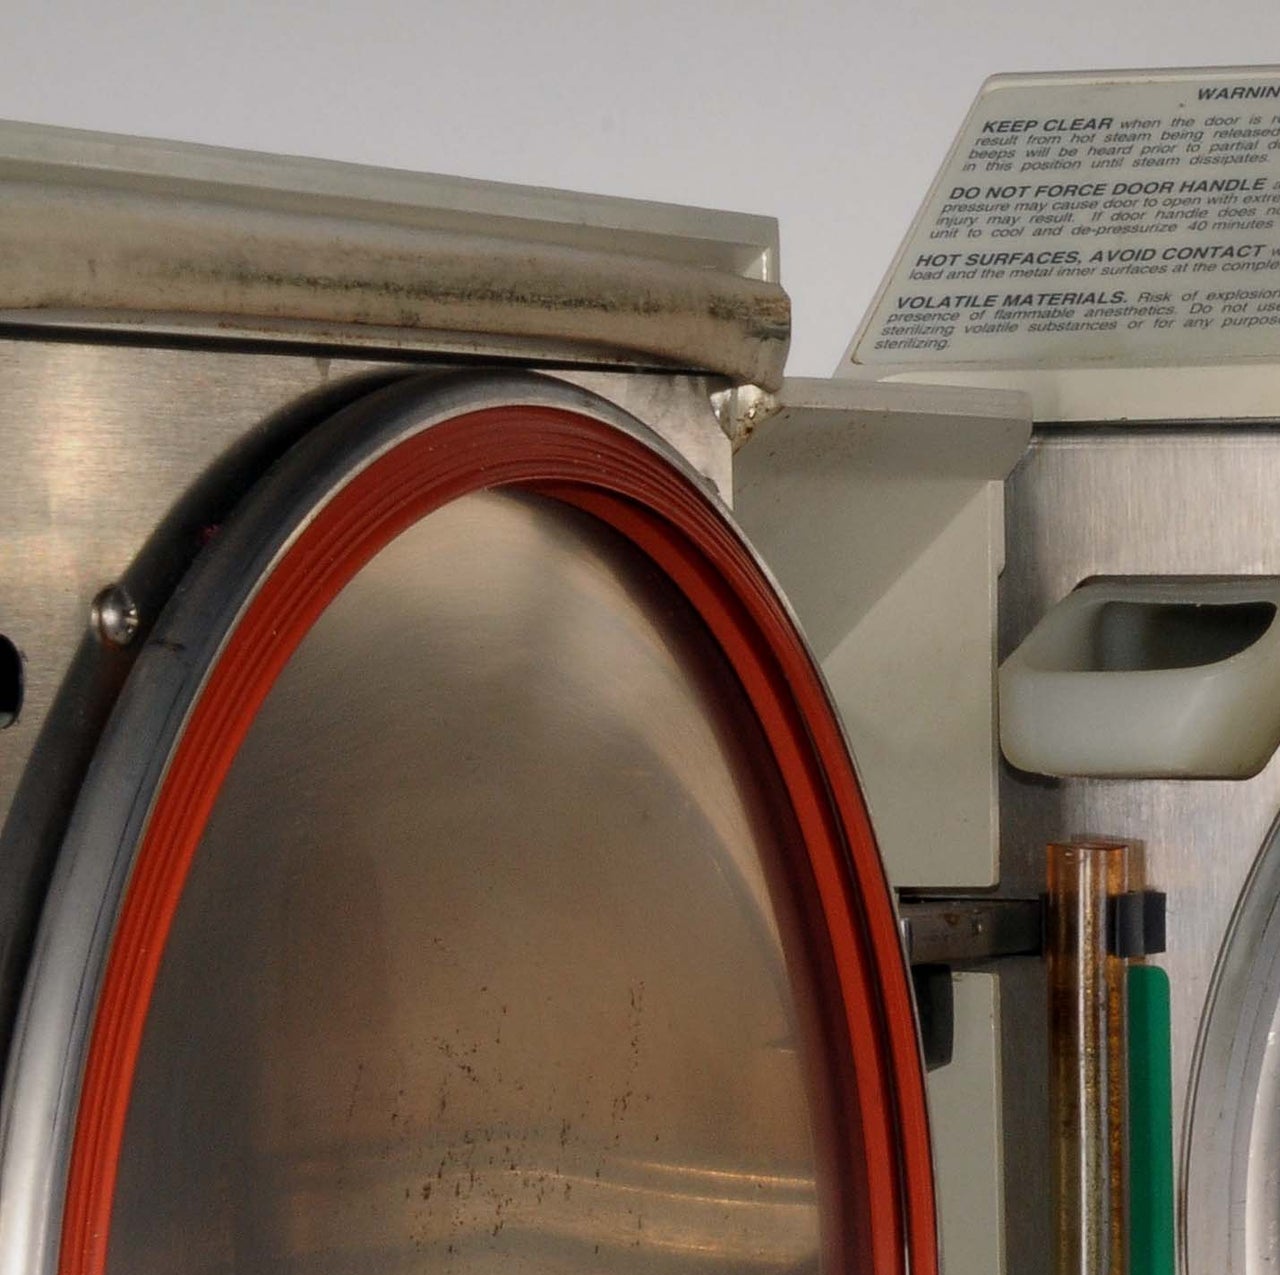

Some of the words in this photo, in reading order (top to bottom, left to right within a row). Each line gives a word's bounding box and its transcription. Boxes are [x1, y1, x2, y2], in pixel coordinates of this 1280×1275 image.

[982, 120, 1038, 133] KEEP
[1043, 118, 1114, 132] CLEAR
[1120, 117, 1161, 129] when
[1171, 116, 1196, 128] the
[1204, 114, 1242, 127] door
[1250, 114, 1262, 125] is
[975, 134, 1019, 147] result
[1026, 134, 1062, 146] from
[1070, 132, 1097, 144] hot
[1104, 131, 1152, 144] steam
[1161, 130, 1204, 145] being
[968, 148, 1016, 162] beeps
[1026, 147, 1050, 158] will
[1058, 146, 1078, 158] be
[1087, 144, 1134, 156] heard
[1140, 143, 1178, 158] prior
[1186, 142, 1202, 153] to
[1208, 139, 1260, 154] partial
[962, 161, 976, 172] in
[985, 160, 1012, 172] this
[1020, 158, 1082, 173] position
[1091, 157, 1124, 170] until
[1132, 156, 1180, 168] steam
[949, 186, 982, 200] DO
[985, 186, 1032, 199] NOT
[1034, 184, 1108, 198] FORCE
[1111, 181, 1174, 196] DOOR
[1179, 178, 1268, 194] HANDLE
[942, 200, 1010, 215] pressure
[1014, 200, 1048, 212] may
[1052, 198, 1098, 211] cause
[1103, 197, 1139, 210] door
[1143, 196, 1158, 208] to
[1162, 195, 1202, 209] open
[1207, 193, 1238, 205] with
[936, 214, 978, 227] injury
[986, 214, 1020, 226] may
[1091, 211, 1104, 222] If
[1110, 210, 1147, 222] door
[1154, 206, 1208, 220] handle
[1218, 206, 1256, 218] does
[930, 228, 960, 240] unit
[967, 227, 982, 239] to
[991, 226, 1025, 238] cool
[1032, 225, 1064, 237] and
[1071, 222, 1178, 238] de-pressurize
[1187, 220, 1208, 231] 40
[1211, 218, 1274, 231] minutes
[916, 254, 962, 268] HOT
[964, 250, 1082, 266] SURFACES,
[1089, 248, 1158, 264] AVOID
[1161, 244, 1267, 261] CONTACT
[908, 268, 944, 281] load
[946, 268, 979, 280] and
[980, 267, 1006, 280] the
[1008, 265, 1054, 279] metal
[1056, 264, 1097, 277] inner
[1100, 262, 1168, 276] surfaces
[1172, 262, 1189, 274] at
[1192, 260, 1218, 273] the
[897, 295, 998, 309] VOLATILE
[1002, 290, 1128, 307] MATERIALS.
[1138, 290, 1172, 303] Risk
[1182, 290, 1198, 302] of
[886, 311, 960, 325] presence
[969, 310, 986, 322] of
[993, 306, 1076, 322] flammable
[1190, 302, 1212, 315] Do
[1221, 302, 1248, 314] not
[881, 324, 955, 338] sterilizing
[964, 320, 1019, 334] volatile
[1028, 318, 1118, 333] substances
[1127, 319, 1145, 330] or
[1152, 316, 1176, 330] for
[1183, 317, 1212, 330] any
